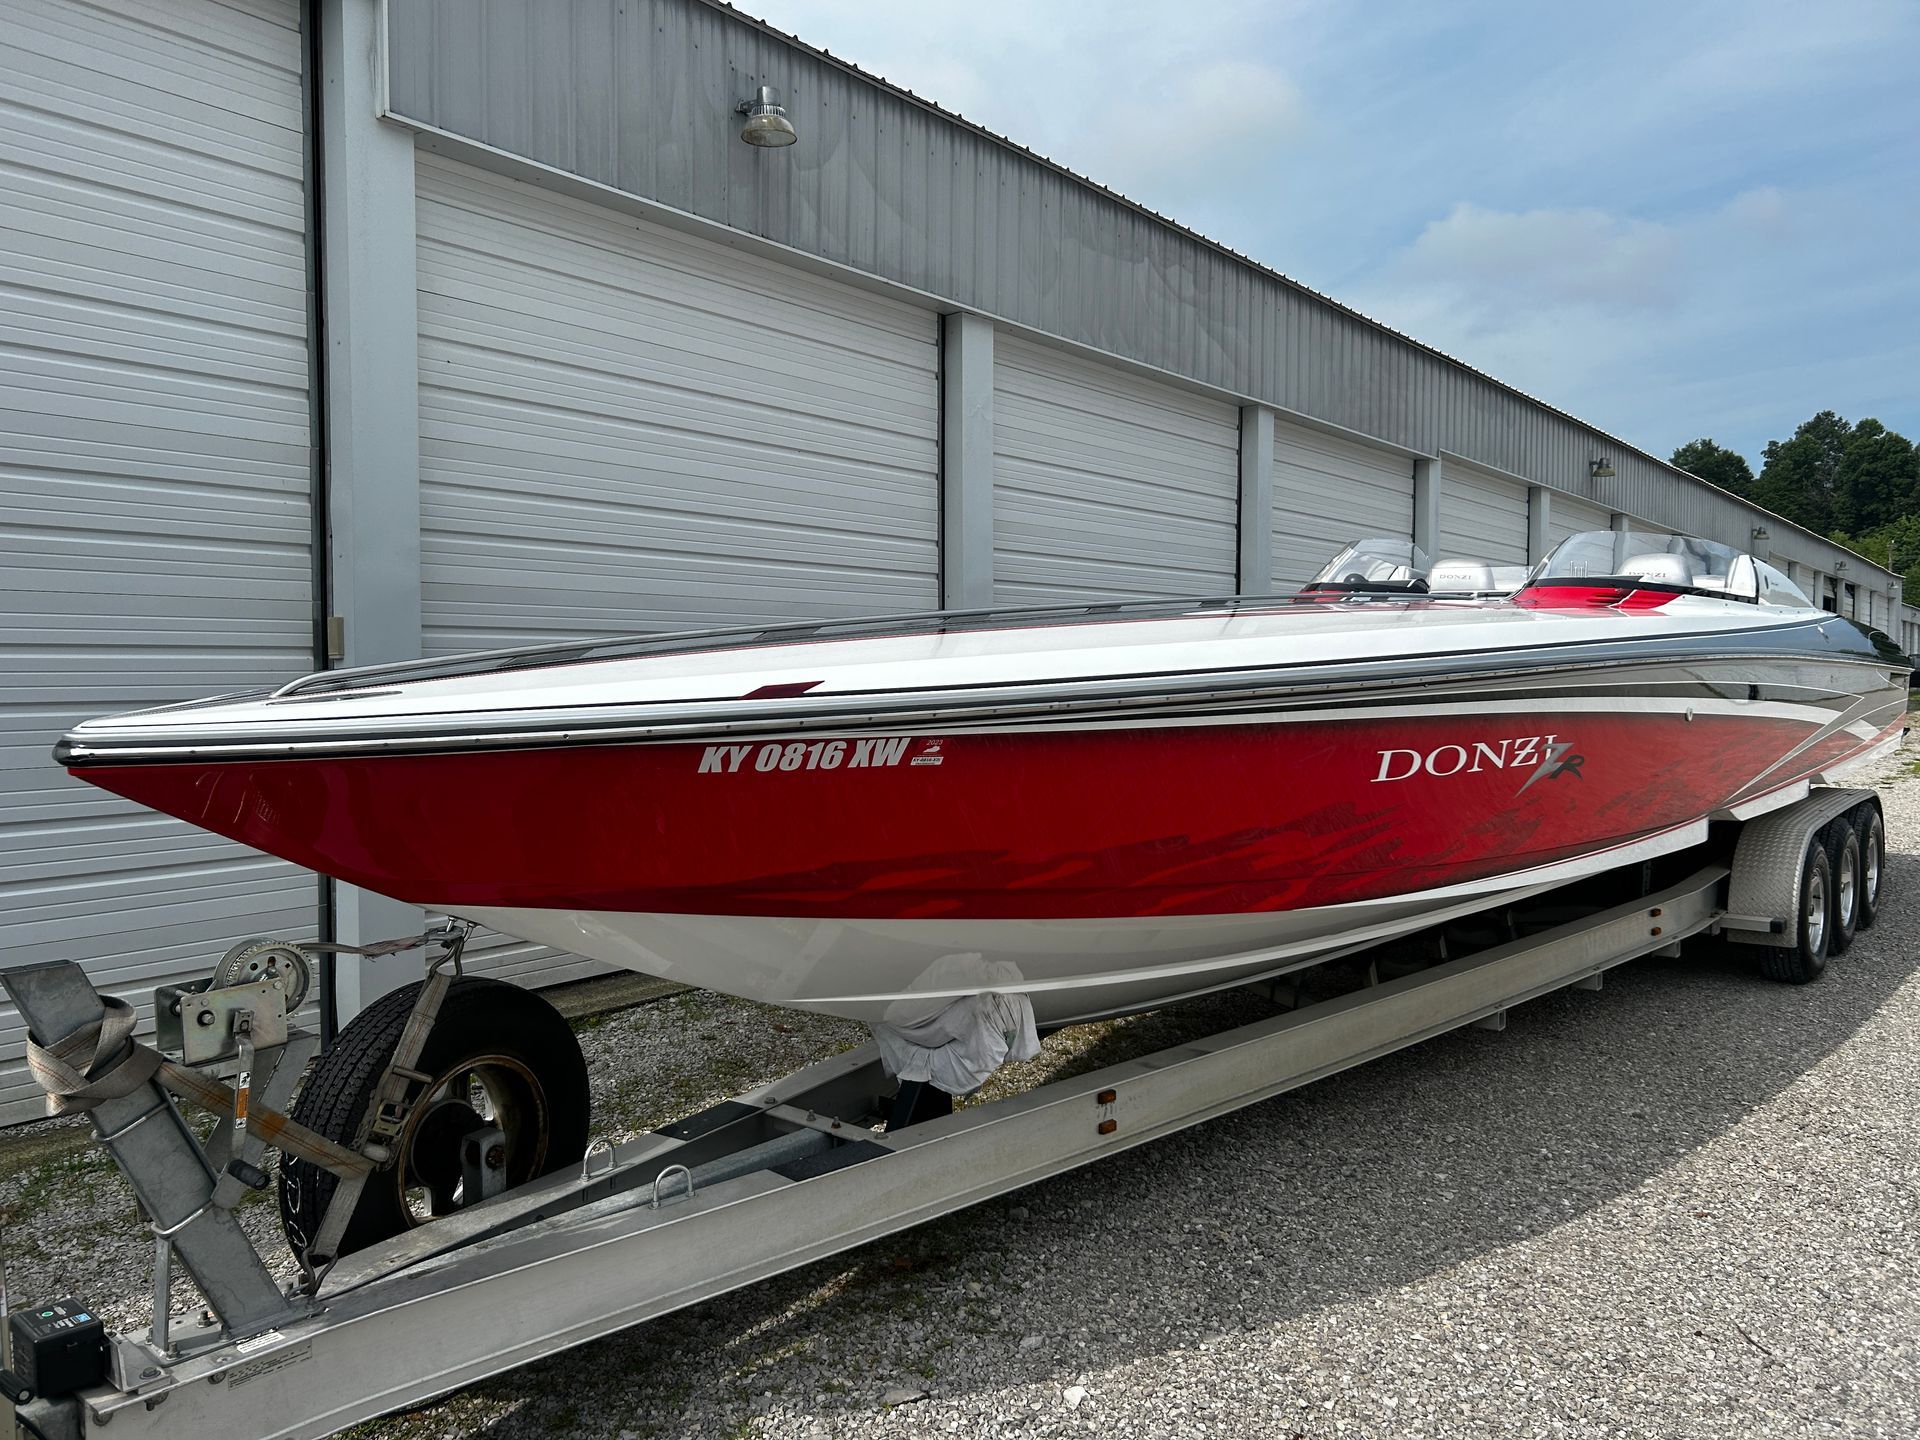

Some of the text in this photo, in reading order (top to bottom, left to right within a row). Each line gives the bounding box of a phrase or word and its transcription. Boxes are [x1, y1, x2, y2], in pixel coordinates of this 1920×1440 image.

[698, 737, 911, 773] KY 0816 XW
[1370, 734, 1558, 782] DONZI
